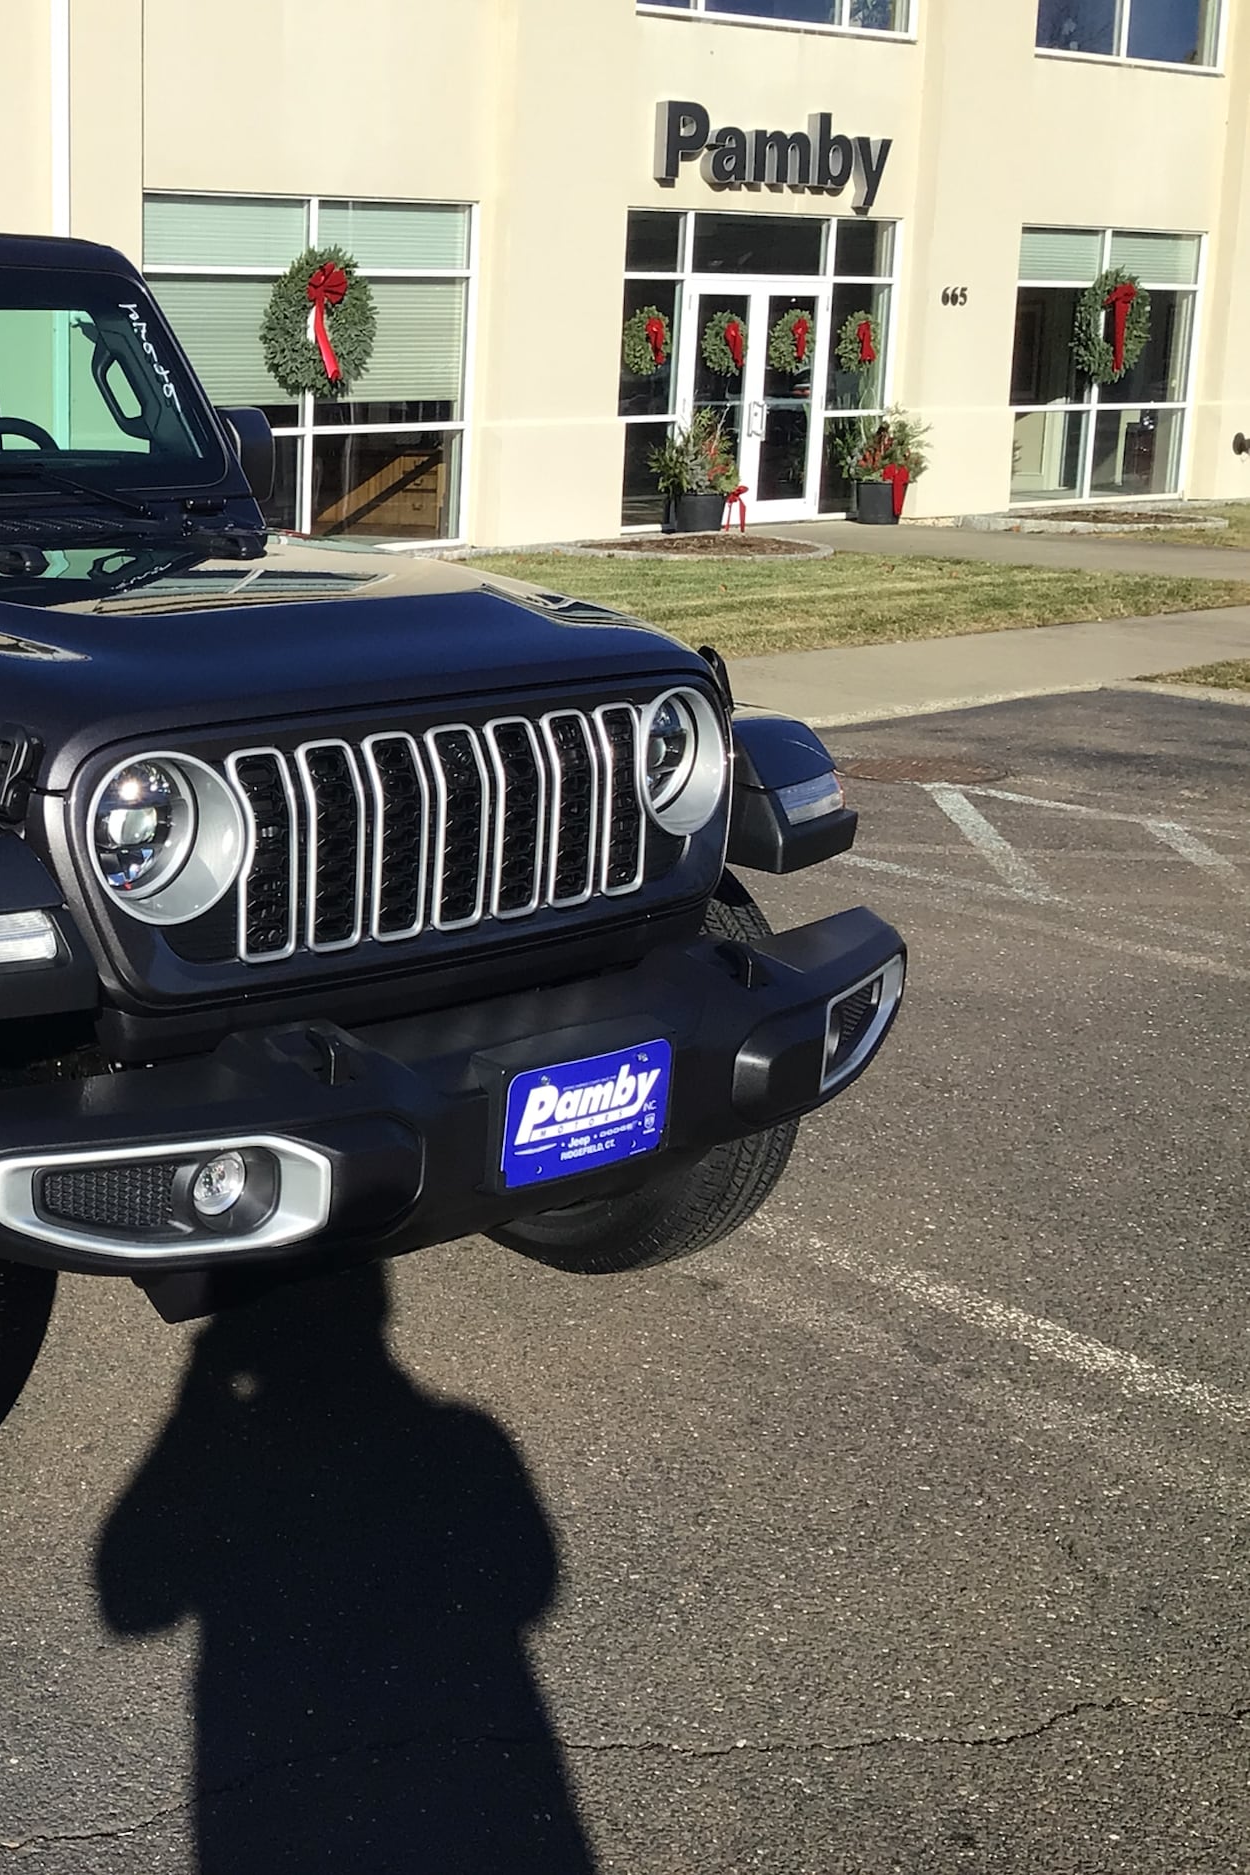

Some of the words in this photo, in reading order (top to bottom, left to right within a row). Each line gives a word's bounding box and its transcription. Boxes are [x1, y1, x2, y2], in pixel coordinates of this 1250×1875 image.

[654, 100, 892, 212] Pamby
[941, 286, 968, 307] 665
[514, 1064, 661, 1146] Pamby
[567, 1135, 591, 1149] Jeep
